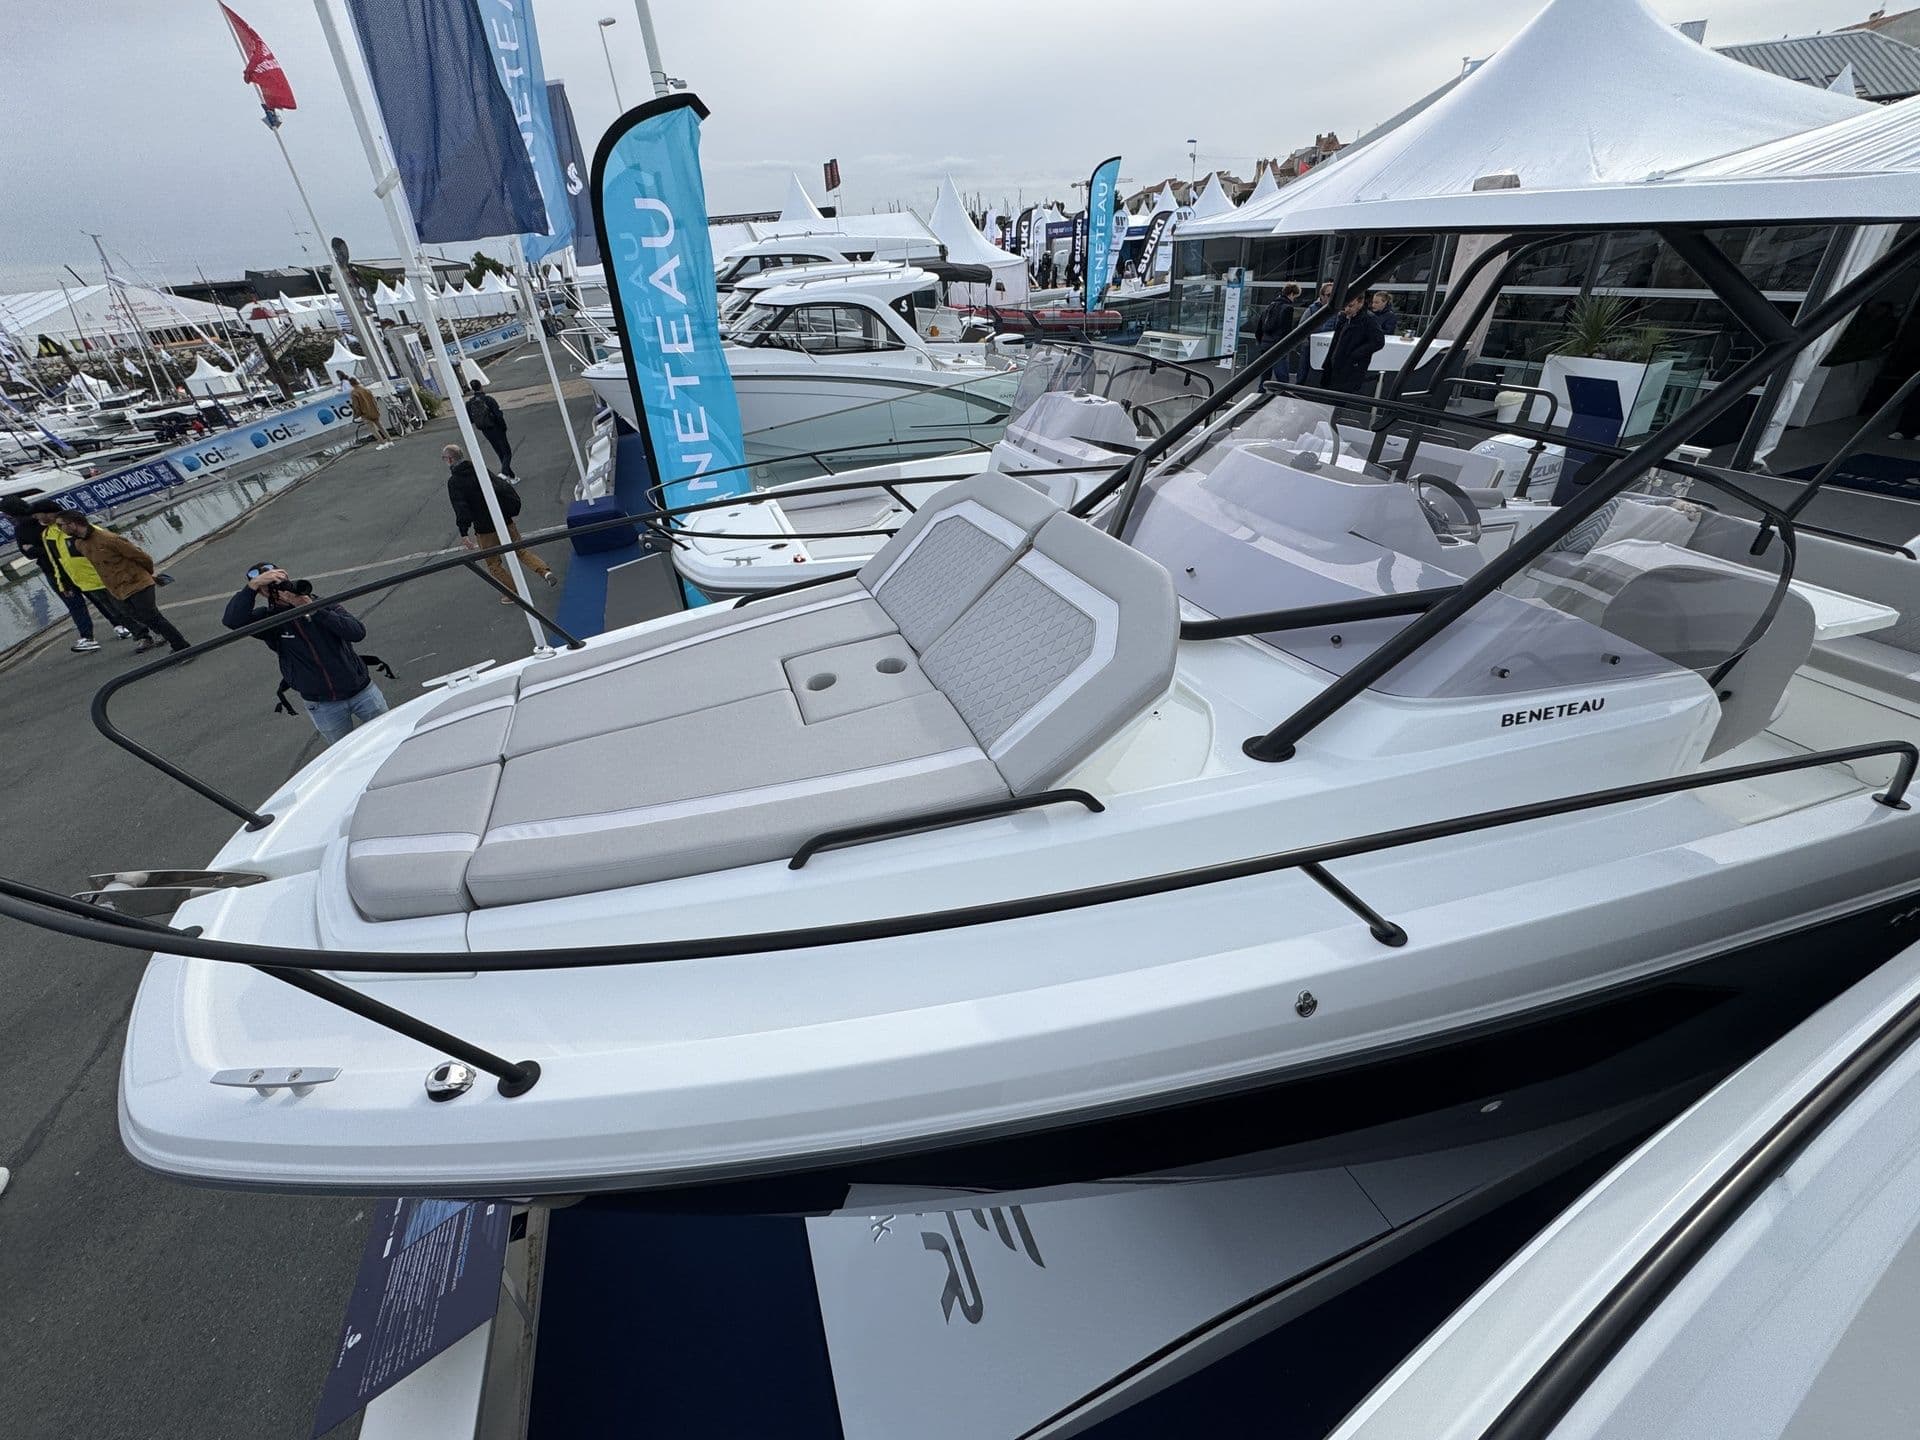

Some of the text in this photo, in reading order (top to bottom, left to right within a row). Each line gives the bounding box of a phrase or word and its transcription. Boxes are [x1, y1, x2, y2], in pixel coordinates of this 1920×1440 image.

[1020, 220, 1030, 257] ZUKI
[1074, 218, 1083, 263] SUZUKI
[1137, 218, 1166, 273] SUZUKI
[634, 197, 728, 497] NETEAU
[264, 423, 292, 443] ici
[198, 447, 226, 467] ici
[1509, 462, 1562, 482] SZUKI
[93, 474, 126, 499] GRAND
[123, 466, 155, 491] PAVOIS
[54, 495, 77, 511] OIS
[1501, 697, 1605, 728] BENETEAU
